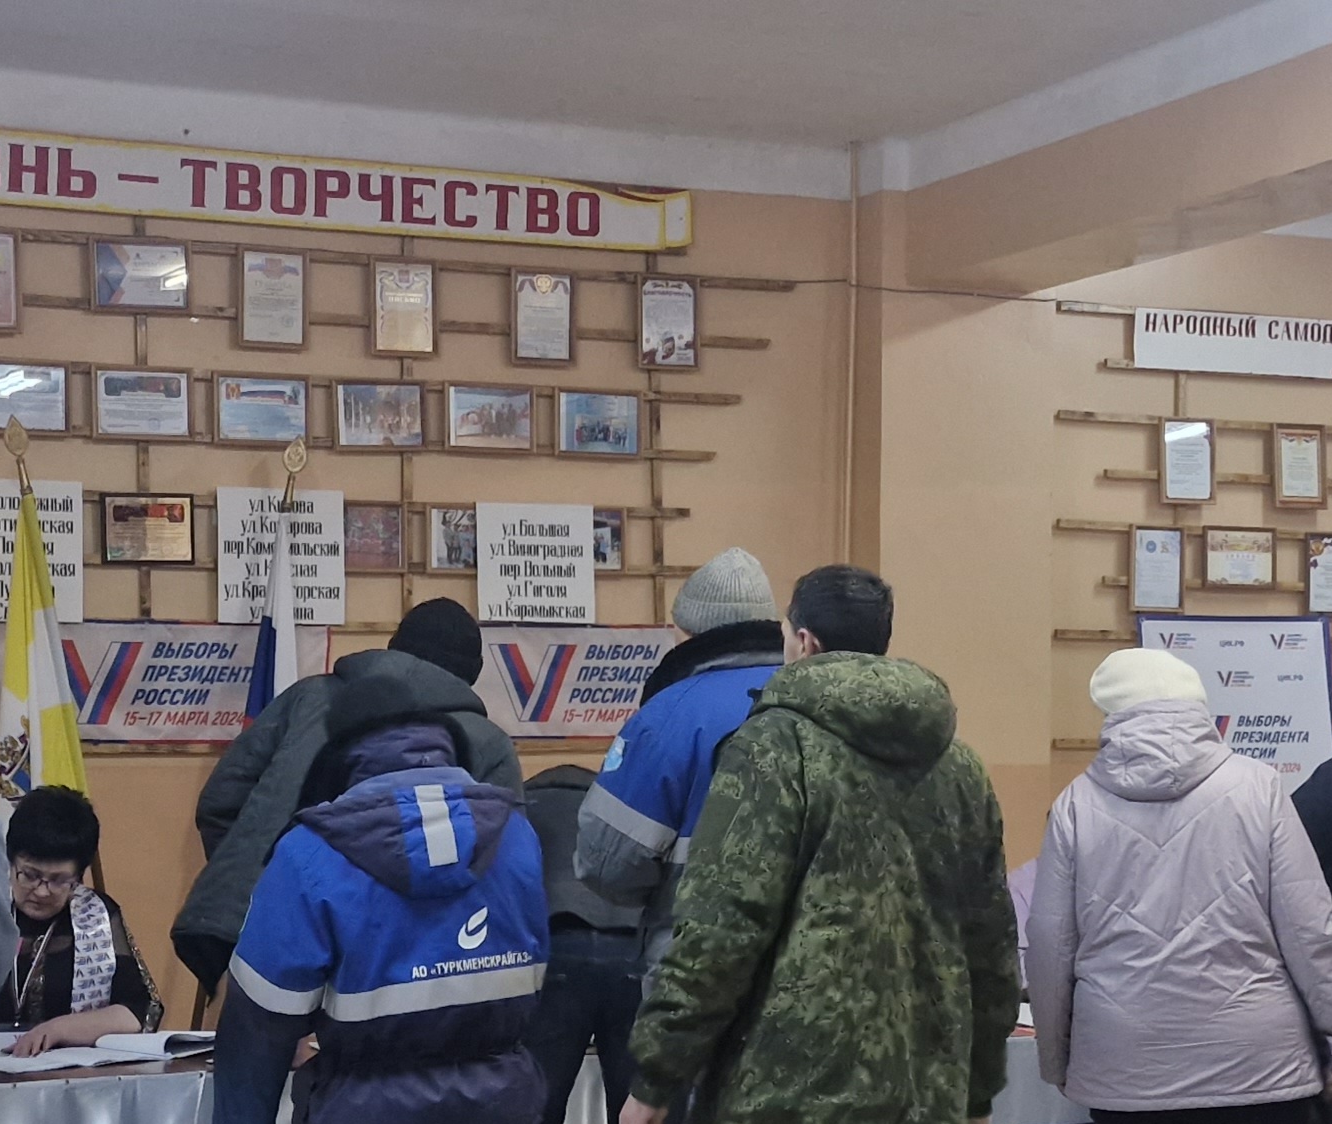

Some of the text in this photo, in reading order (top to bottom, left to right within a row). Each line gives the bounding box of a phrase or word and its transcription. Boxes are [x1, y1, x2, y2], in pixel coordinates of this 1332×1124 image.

[180, 158, 601, 238] ТВОРЧЕСТВО
[1144, 312, 1257, 338] НАРОДНЫЙ
[519, 519, 569, 537] Большая
[508, 539, 584, 560] Виноградная
[524, 560, 576, 578] Вольный
[524, 580, 567, 598] Гоголя
[505, 600, 586, 620] Карамыкская
[151, 641, 238, 660] ВЫБОРЫ
[584, 644, 661, 660] ВЫБОРЫ
[141, 665, 254, 685] ПРЕЗИДЕНТ
[576, 666, 654, 684] ПРЕЗИДЕ
[131, 688, 211, 706] РОССИИ
[568, 688, 638, 704] РОССИИ
[163, 711, 209, 726] МАРТА
[1237, 715, 1292, 727] ВЫБОРЫ
[1231, 731, 1309, 744] ПРЕЗИДЕНТА
[1279, 762, 1302, 774] 2024
[412, 965, 427, 979] АО
